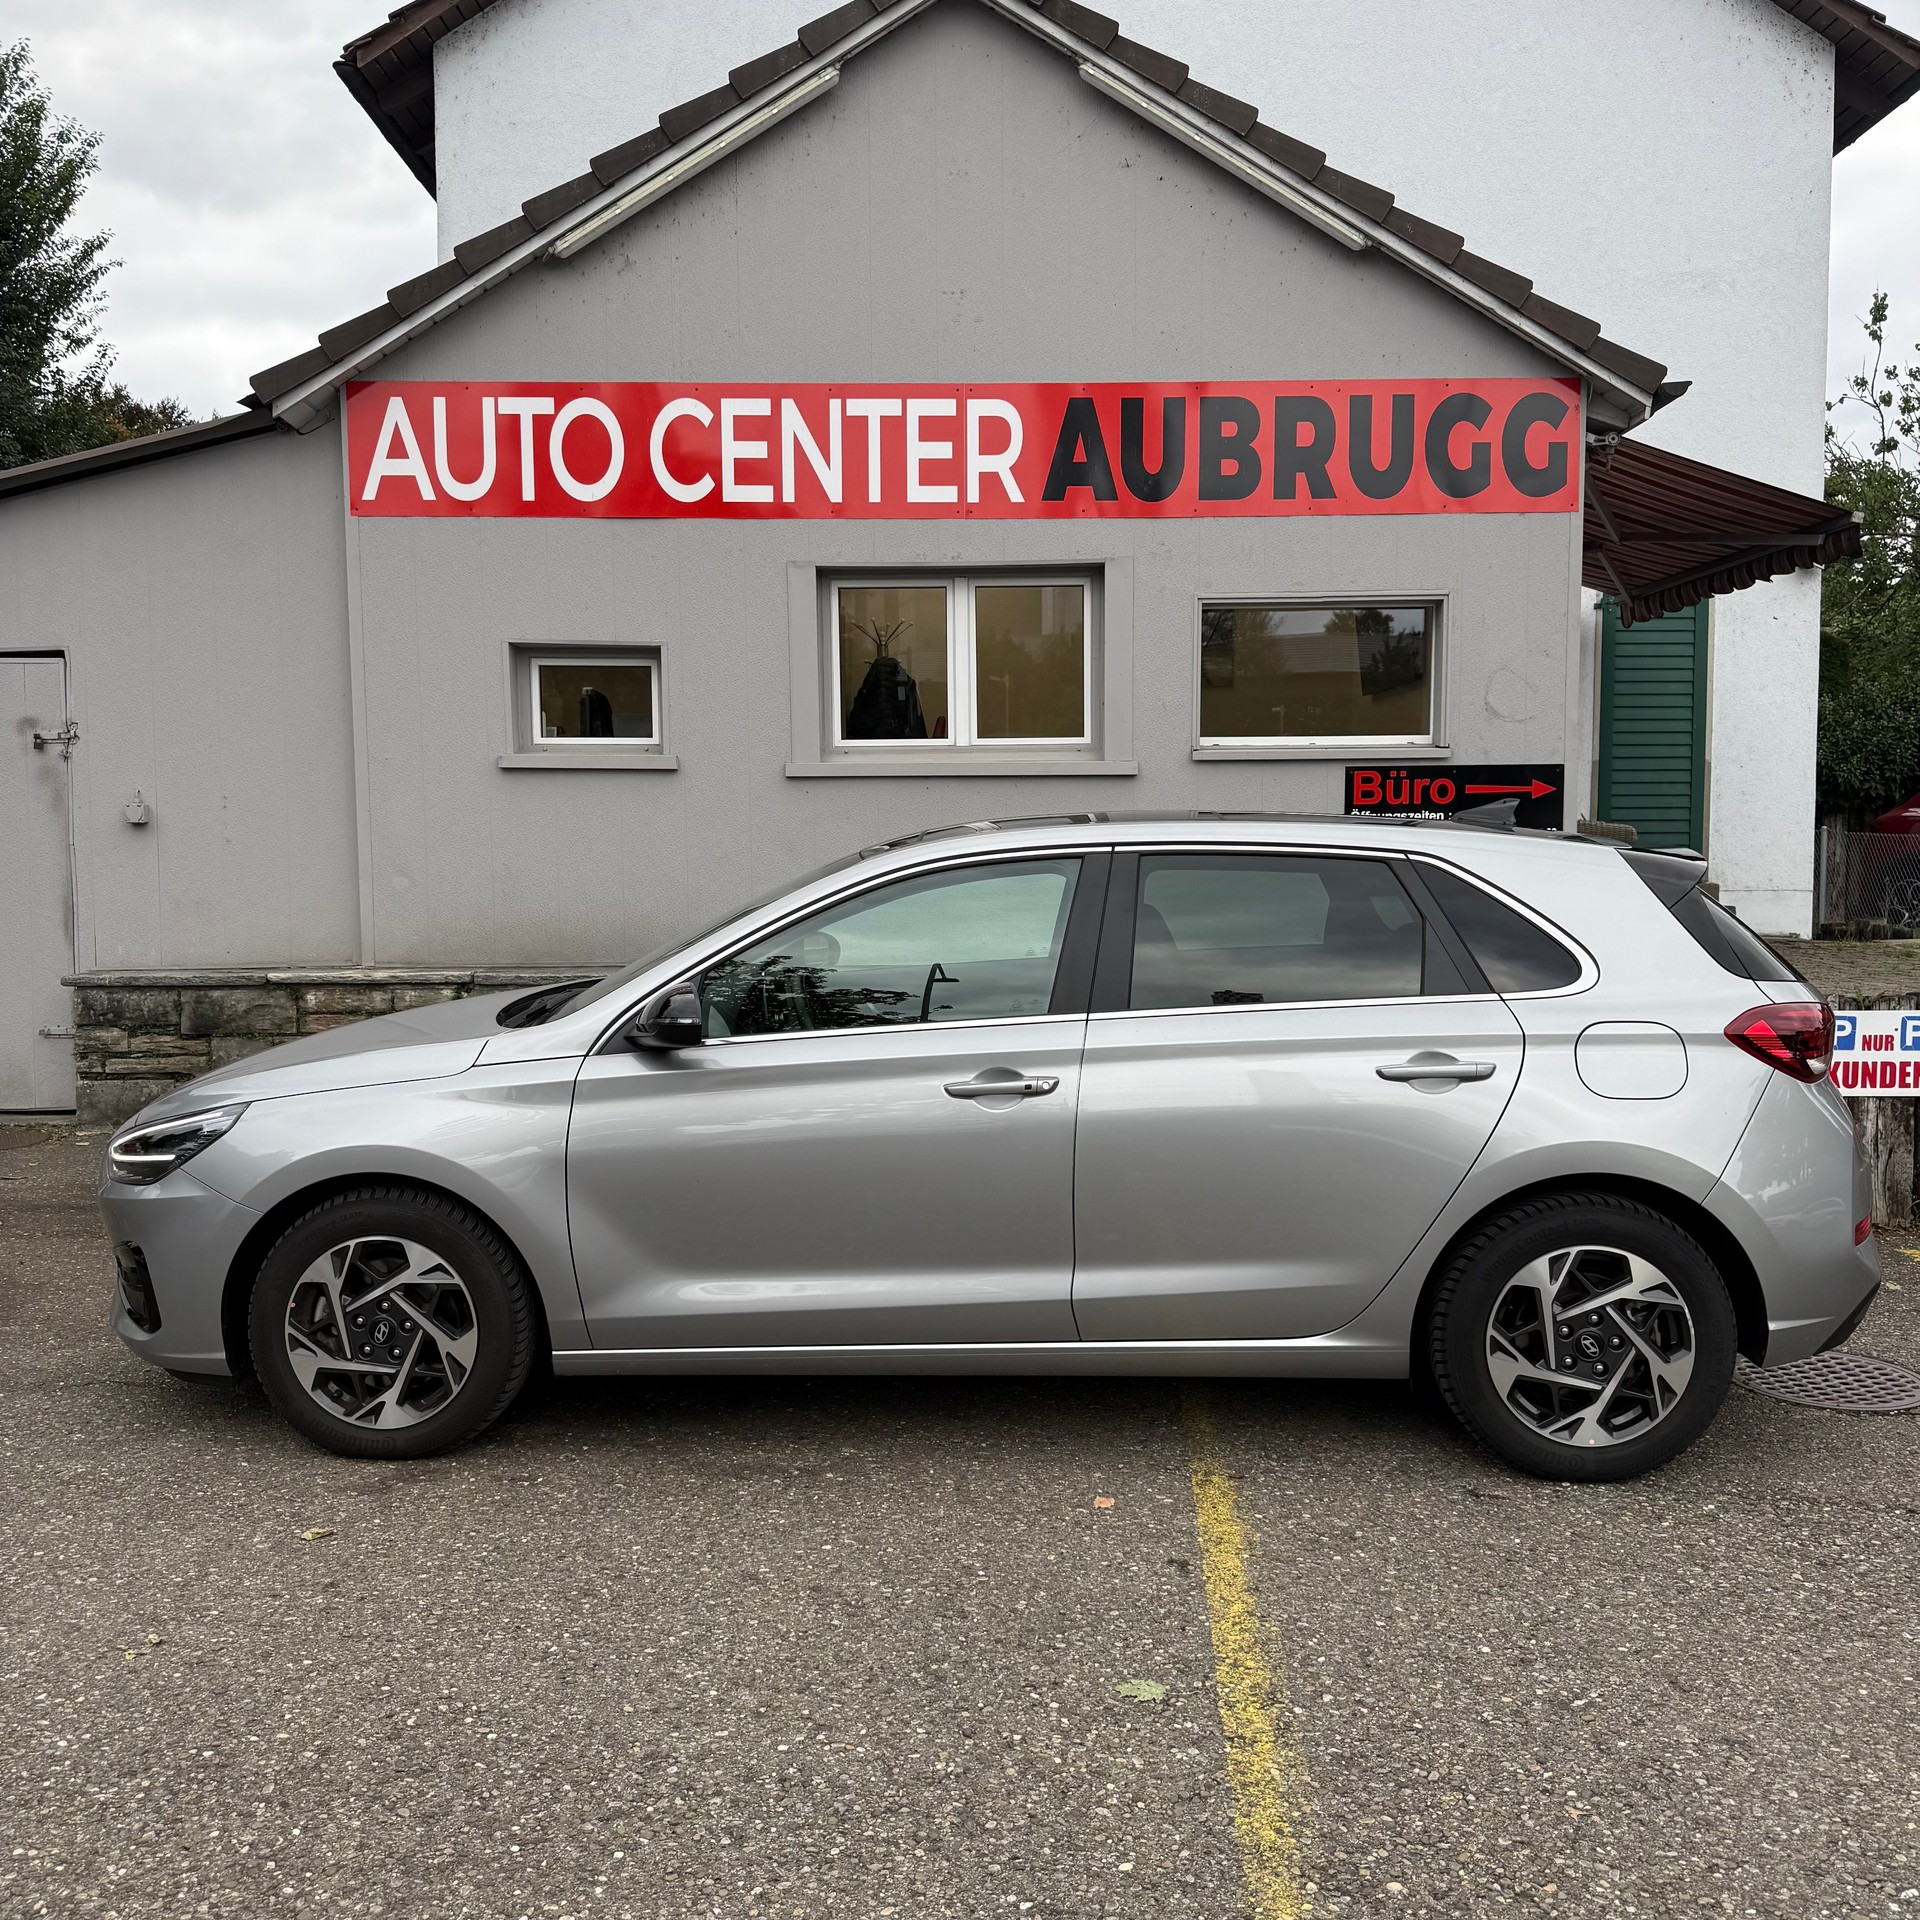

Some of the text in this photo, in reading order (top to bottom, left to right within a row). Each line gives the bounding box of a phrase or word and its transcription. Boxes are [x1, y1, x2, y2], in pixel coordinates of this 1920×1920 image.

[362, 392, 1570, 503] AUTO CENTER AUBRUGG
[1353, 770, 1456, 805] Büro
[1861, 1034, 1895, 1051] NUR
